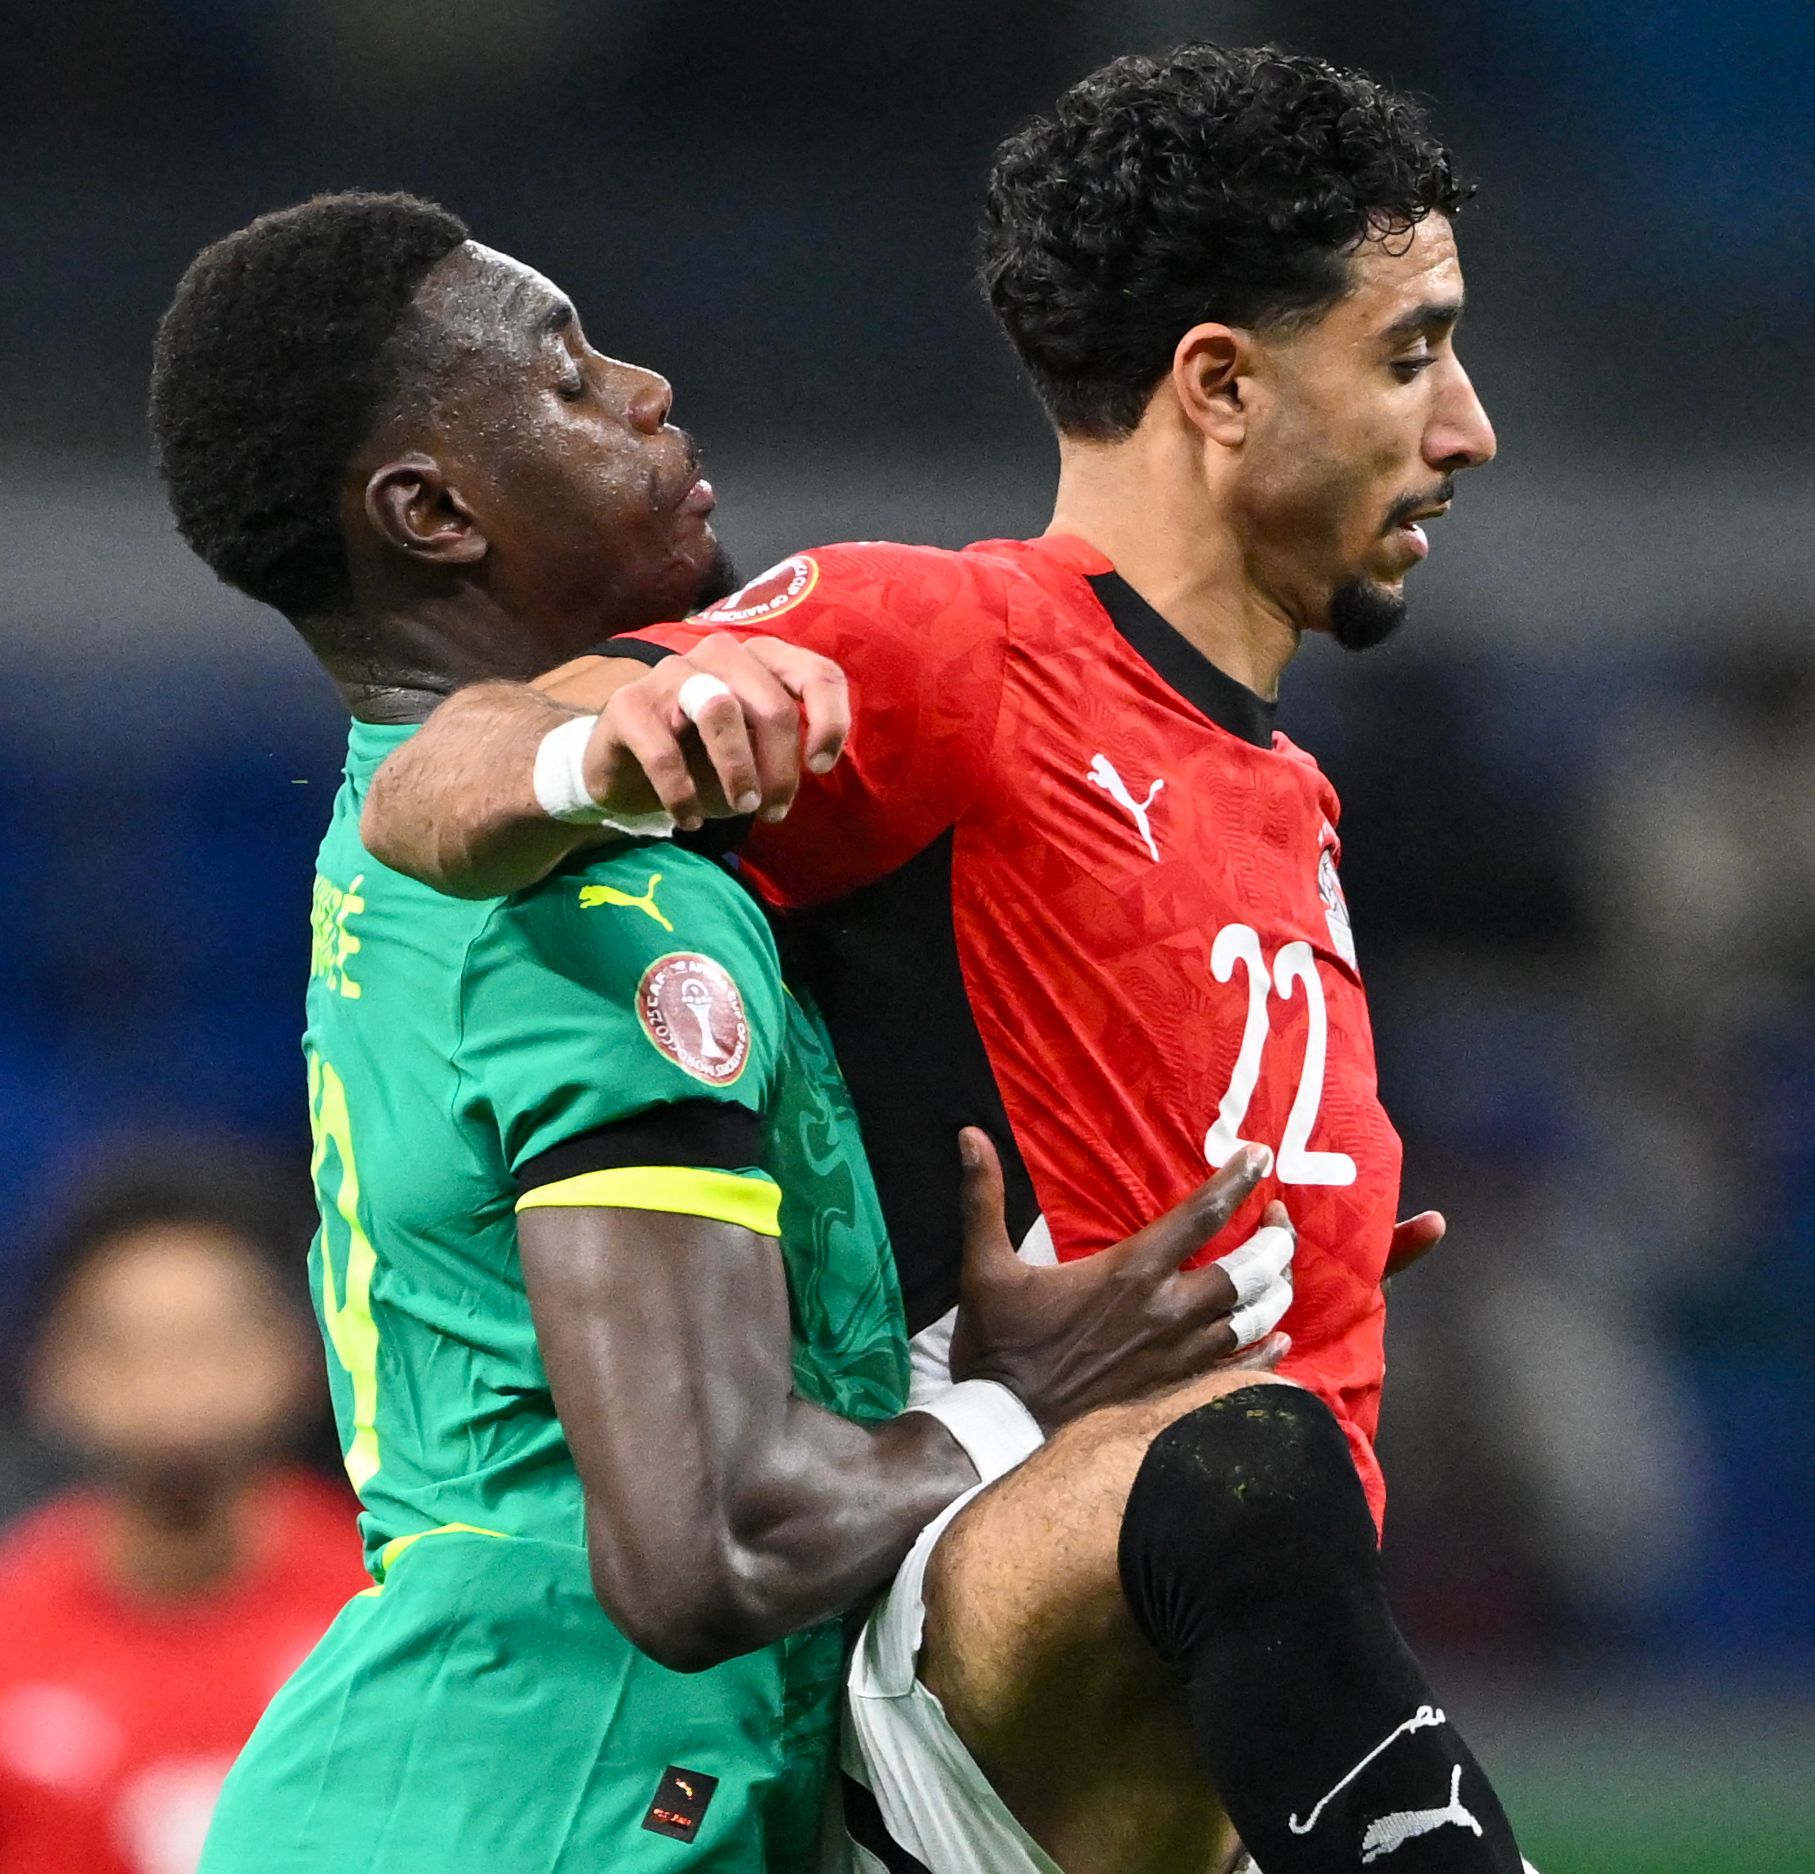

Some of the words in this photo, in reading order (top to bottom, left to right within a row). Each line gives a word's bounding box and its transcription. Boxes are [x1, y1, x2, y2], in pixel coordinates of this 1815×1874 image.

[788, 575, 807, 596] CUP
[769, 594, 789, 609] OF
[647, 971, 666, 1007] CAF
[647, 1009, 662, 1027] 25
[1204, 923, 1357, 1186] 22
